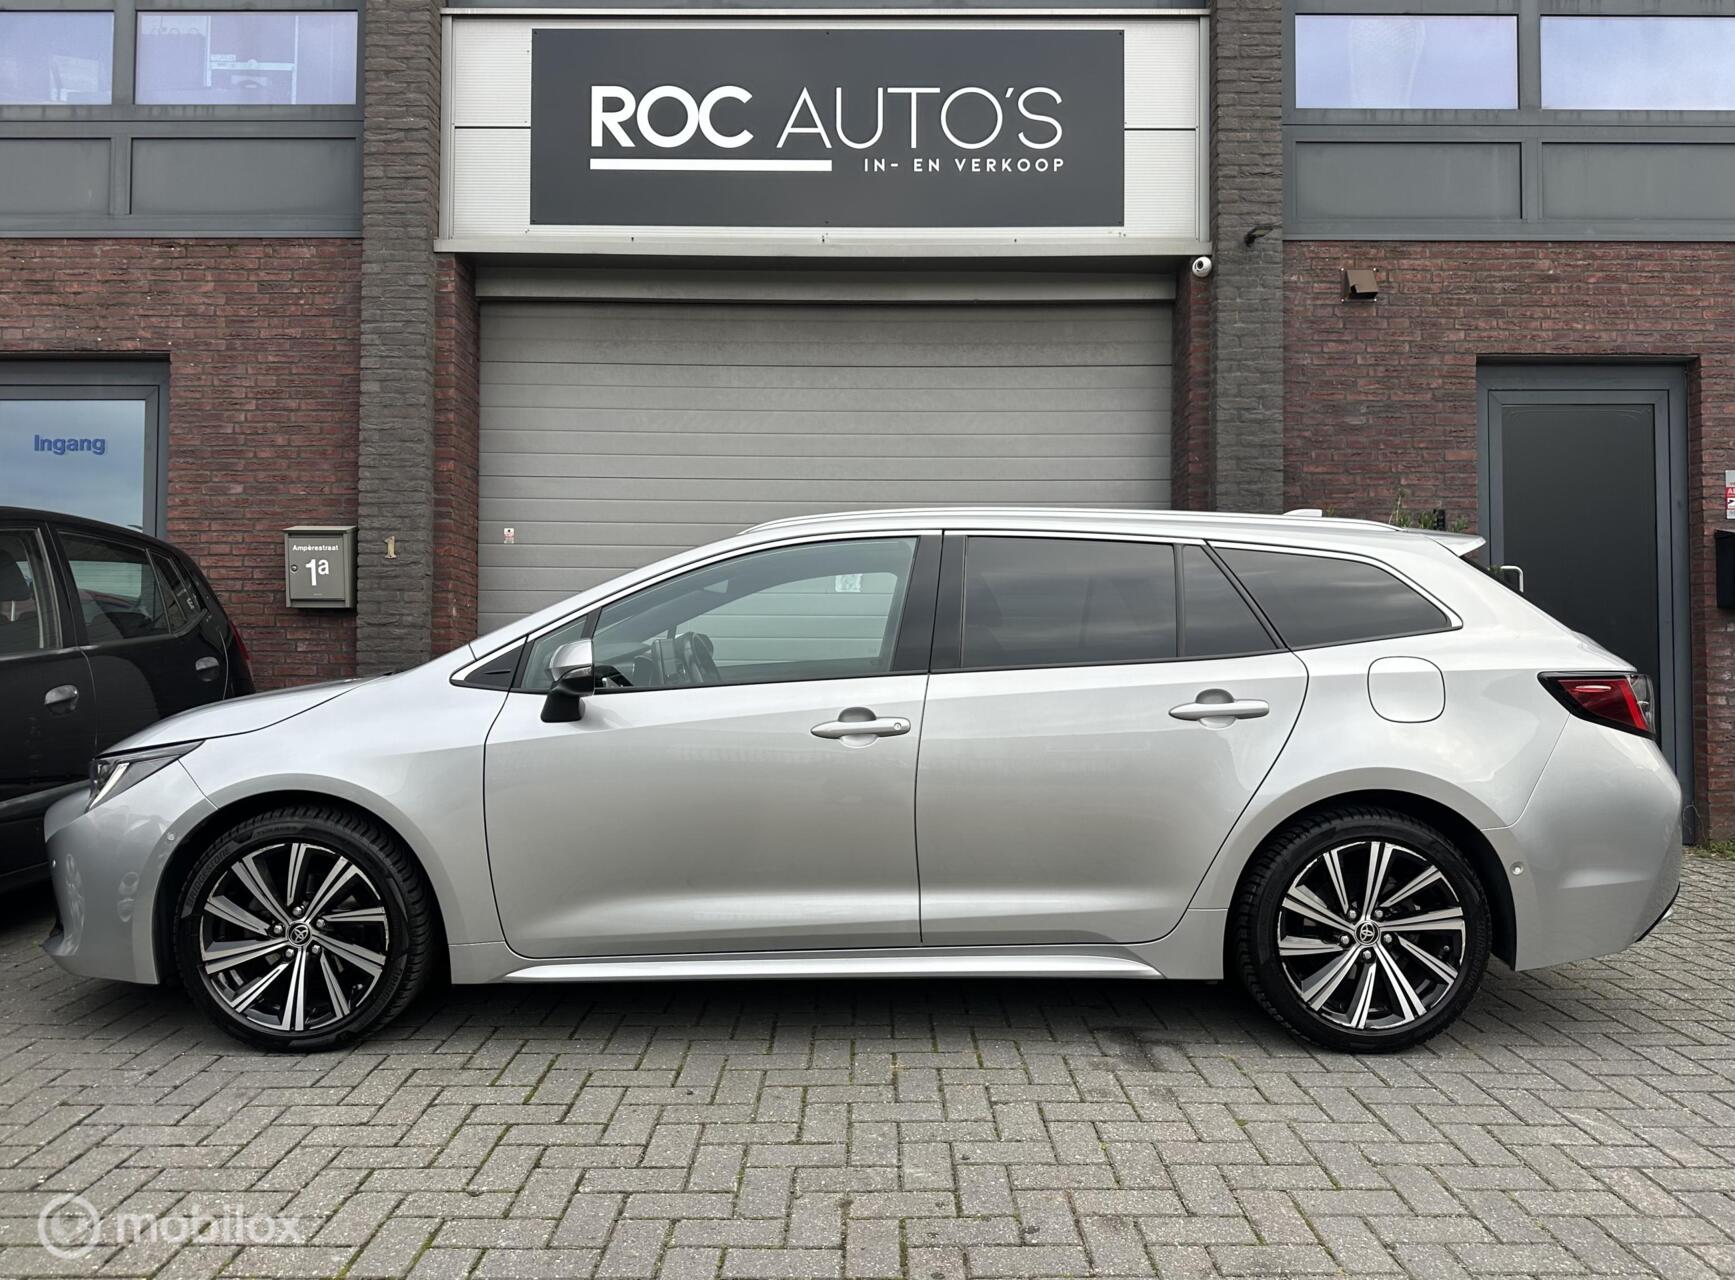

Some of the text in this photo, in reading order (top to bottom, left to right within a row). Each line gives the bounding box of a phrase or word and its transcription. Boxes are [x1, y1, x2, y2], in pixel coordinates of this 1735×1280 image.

[590, 85, 1063, 149] ROC AUTO'S
[864, 158, 1065, 172] IN- EN VERKOOP
[34, 434, 106, 455] Ingang
[384, 535, 397, 558] 1
[305, 559, 330, 586] 1a
